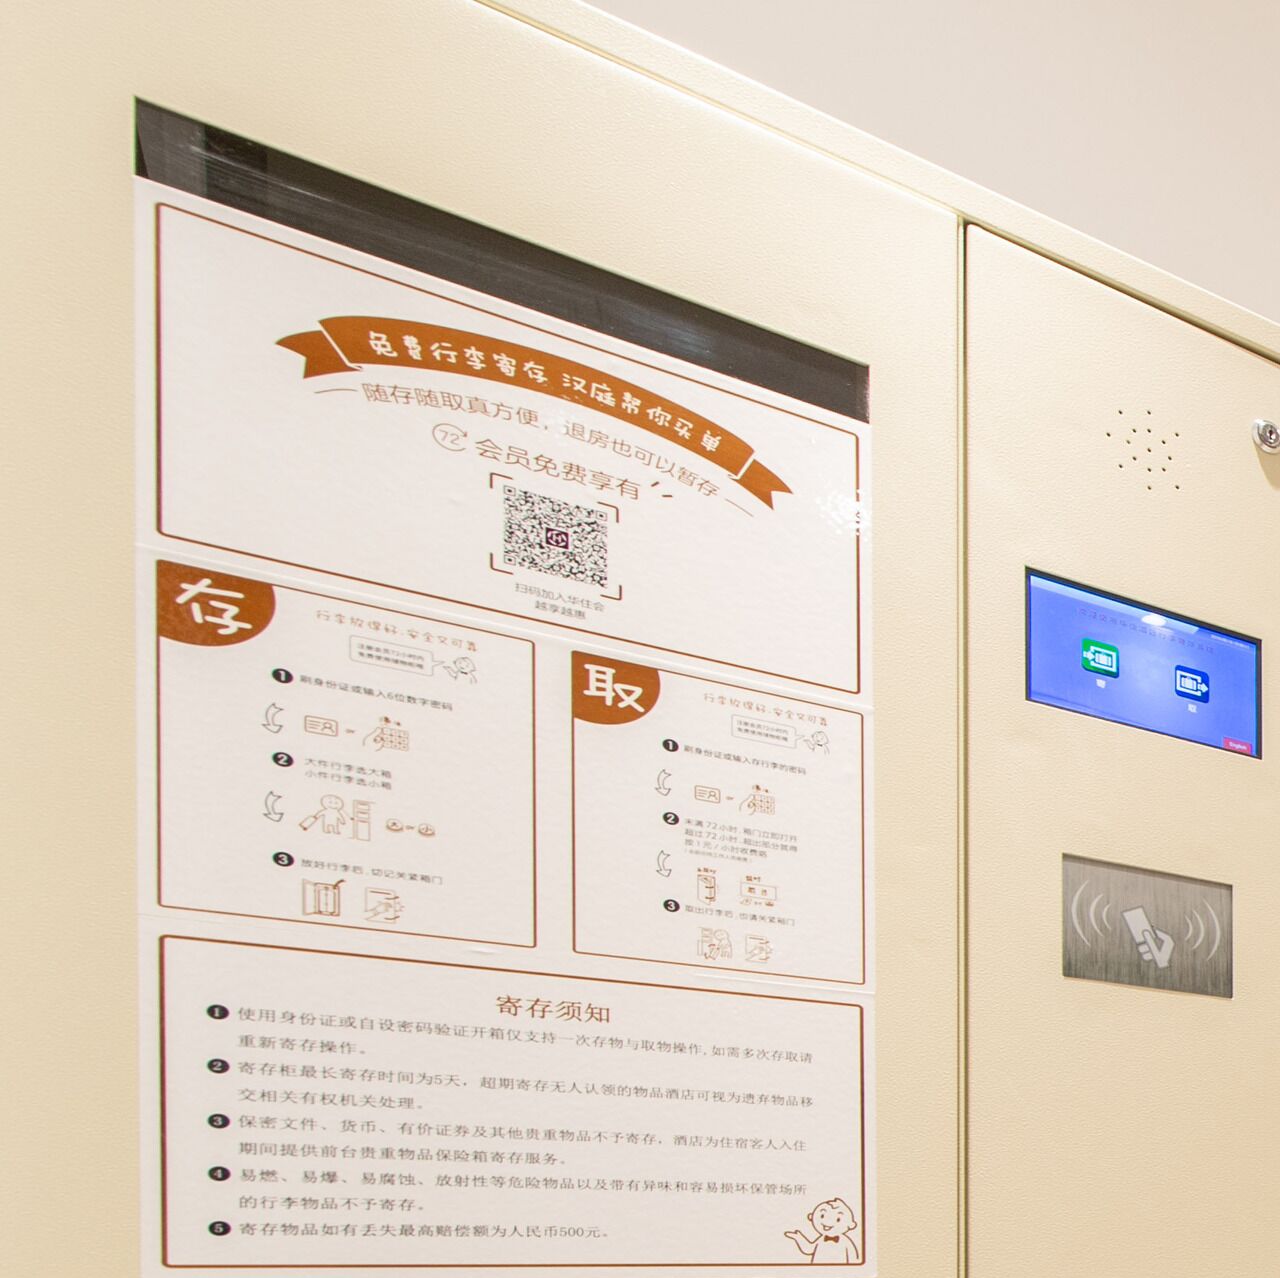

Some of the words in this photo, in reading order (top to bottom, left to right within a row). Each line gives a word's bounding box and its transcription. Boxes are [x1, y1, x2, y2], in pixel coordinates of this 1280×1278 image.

[438, 429, 461, 446] 72
[474, 438, 641, 501] 会员免费享有
[174, 577, 253, 636] 存
[582, 662, 646, 713] 取
[495, 993, 611, 1024] 寄存须知
[237, 1034, 367, 1056] 重新寄存操作。
[238, 1087, 424, 1110] 交相关有权机关处理。
[239, 1194, 425, 1212] 的行李物品不予寄存。
